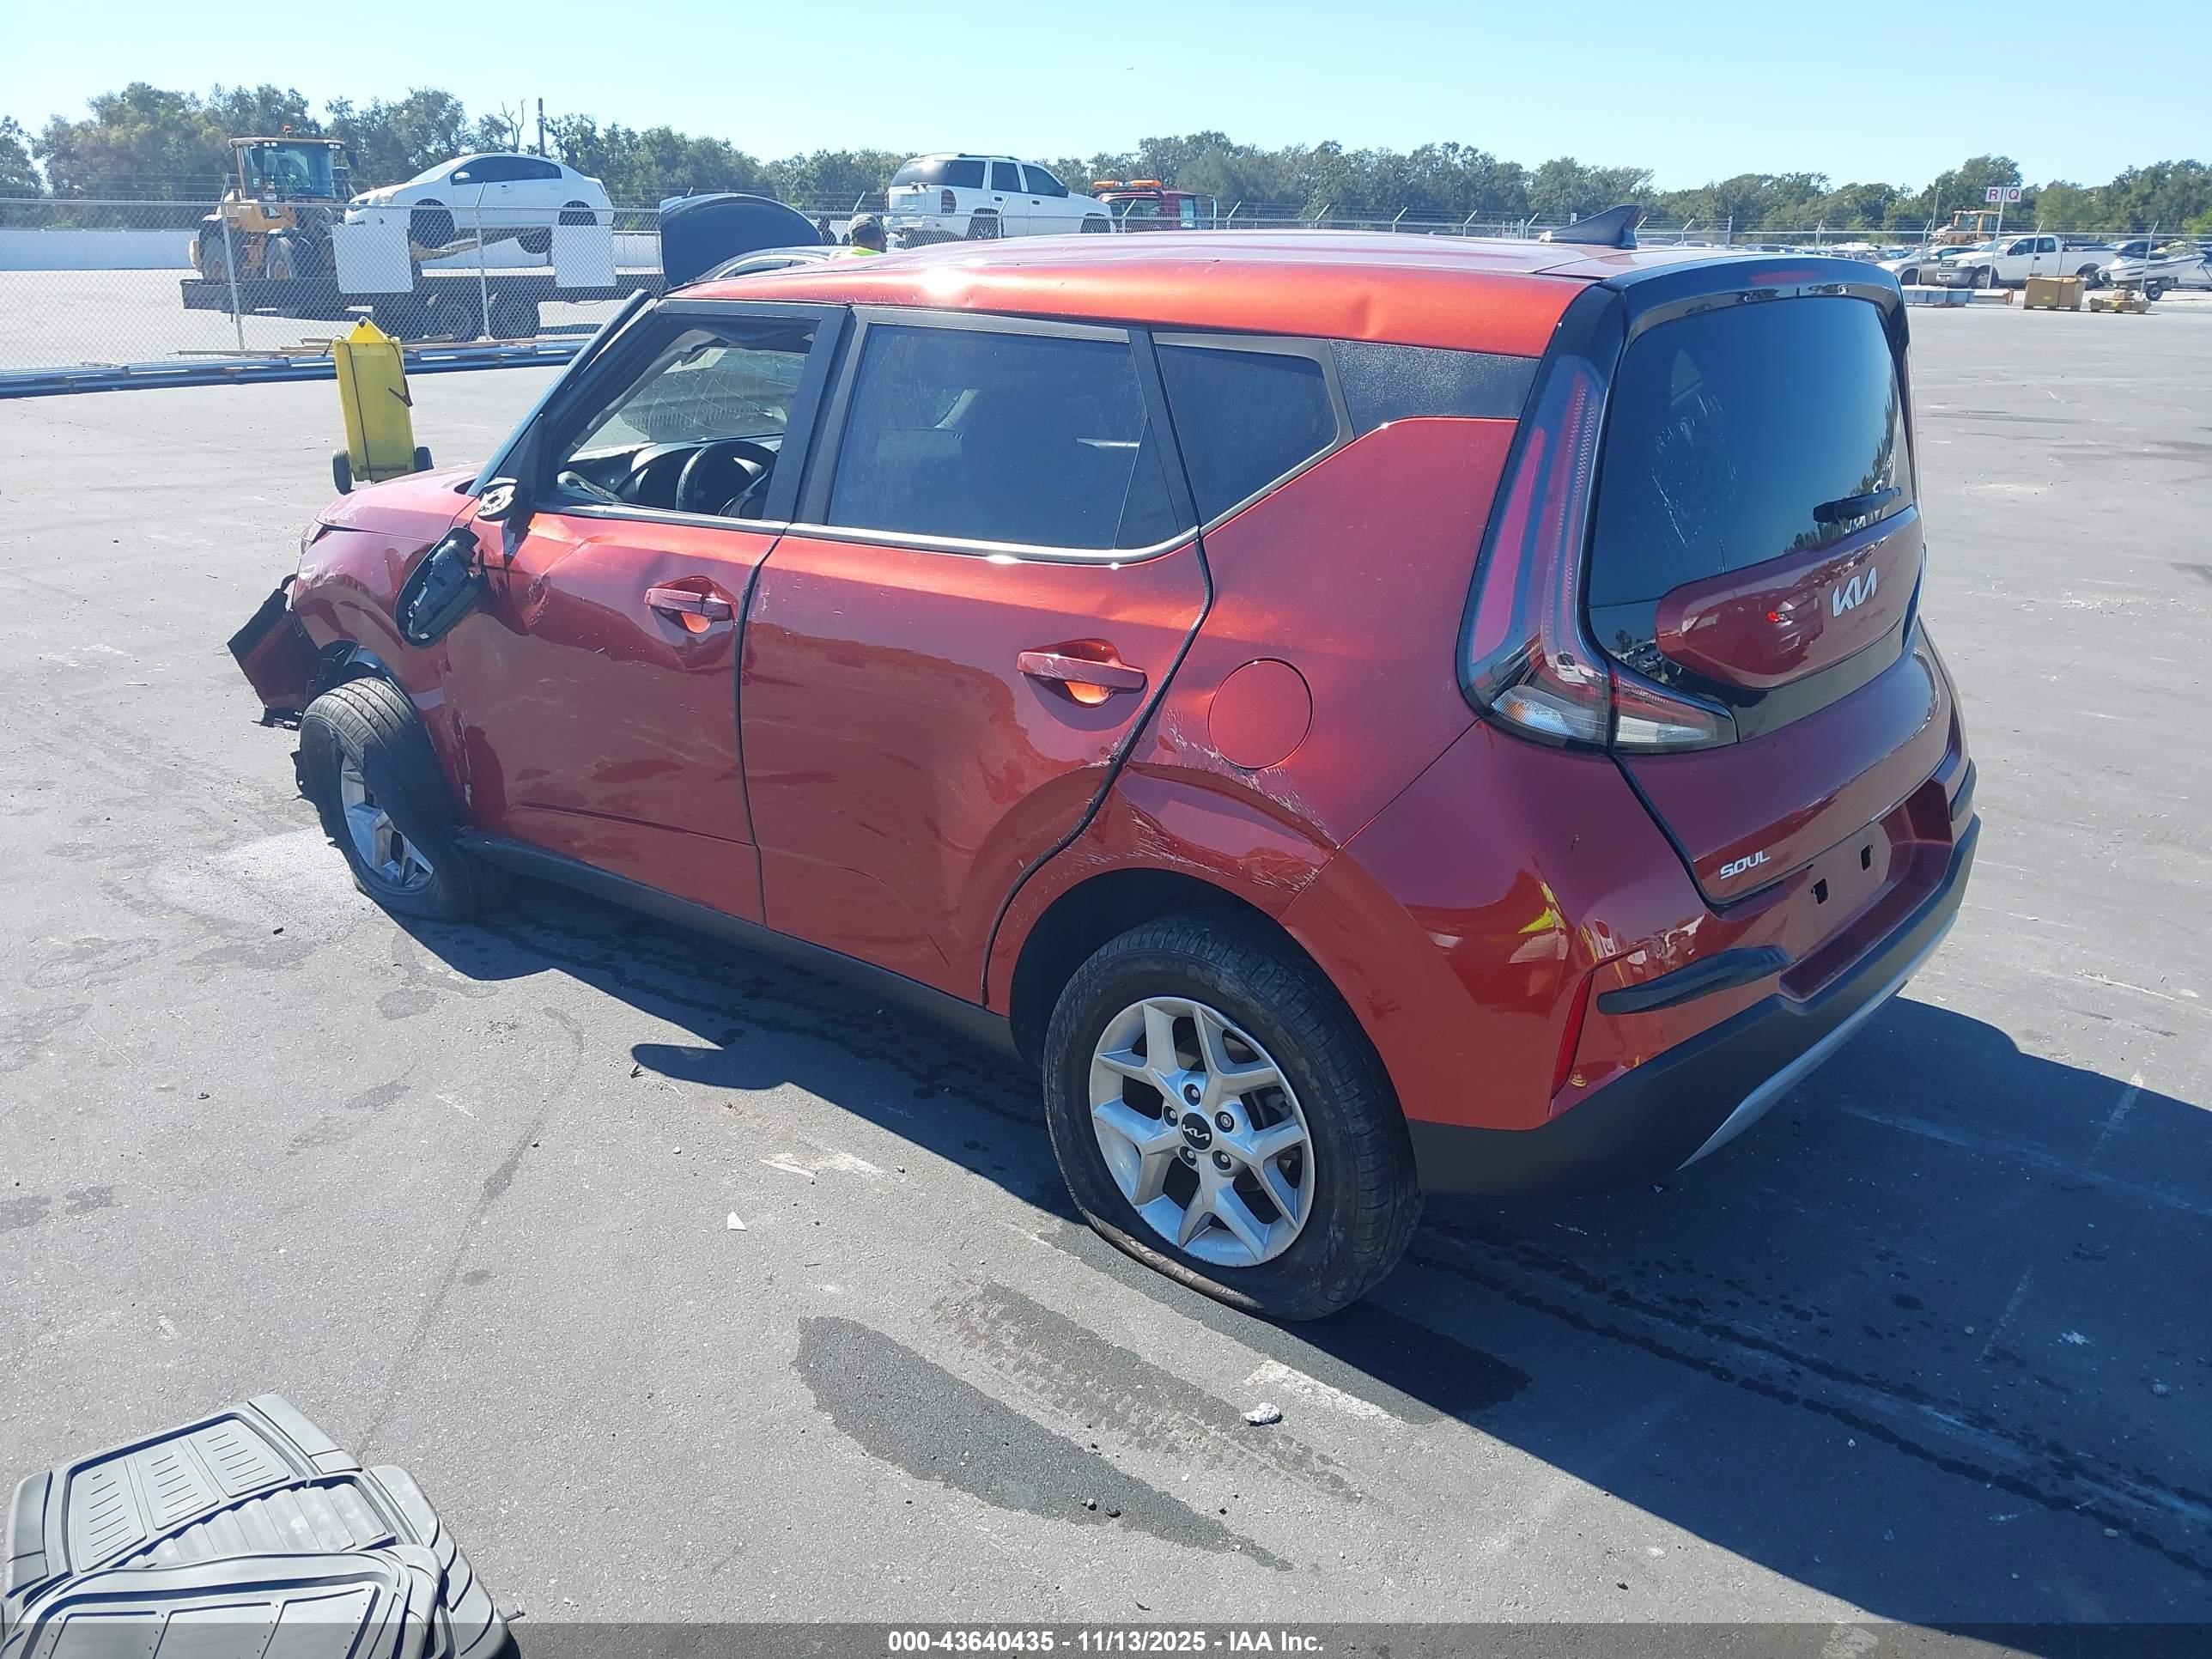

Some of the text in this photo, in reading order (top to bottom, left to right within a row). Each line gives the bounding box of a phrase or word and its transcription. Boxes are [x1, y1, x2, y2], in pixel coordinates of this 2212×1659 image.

[1989, 189, 1998, 199] R
[2008, 188, 2020, 199] Q
[1720, 850, 1771, 880] SOUL
